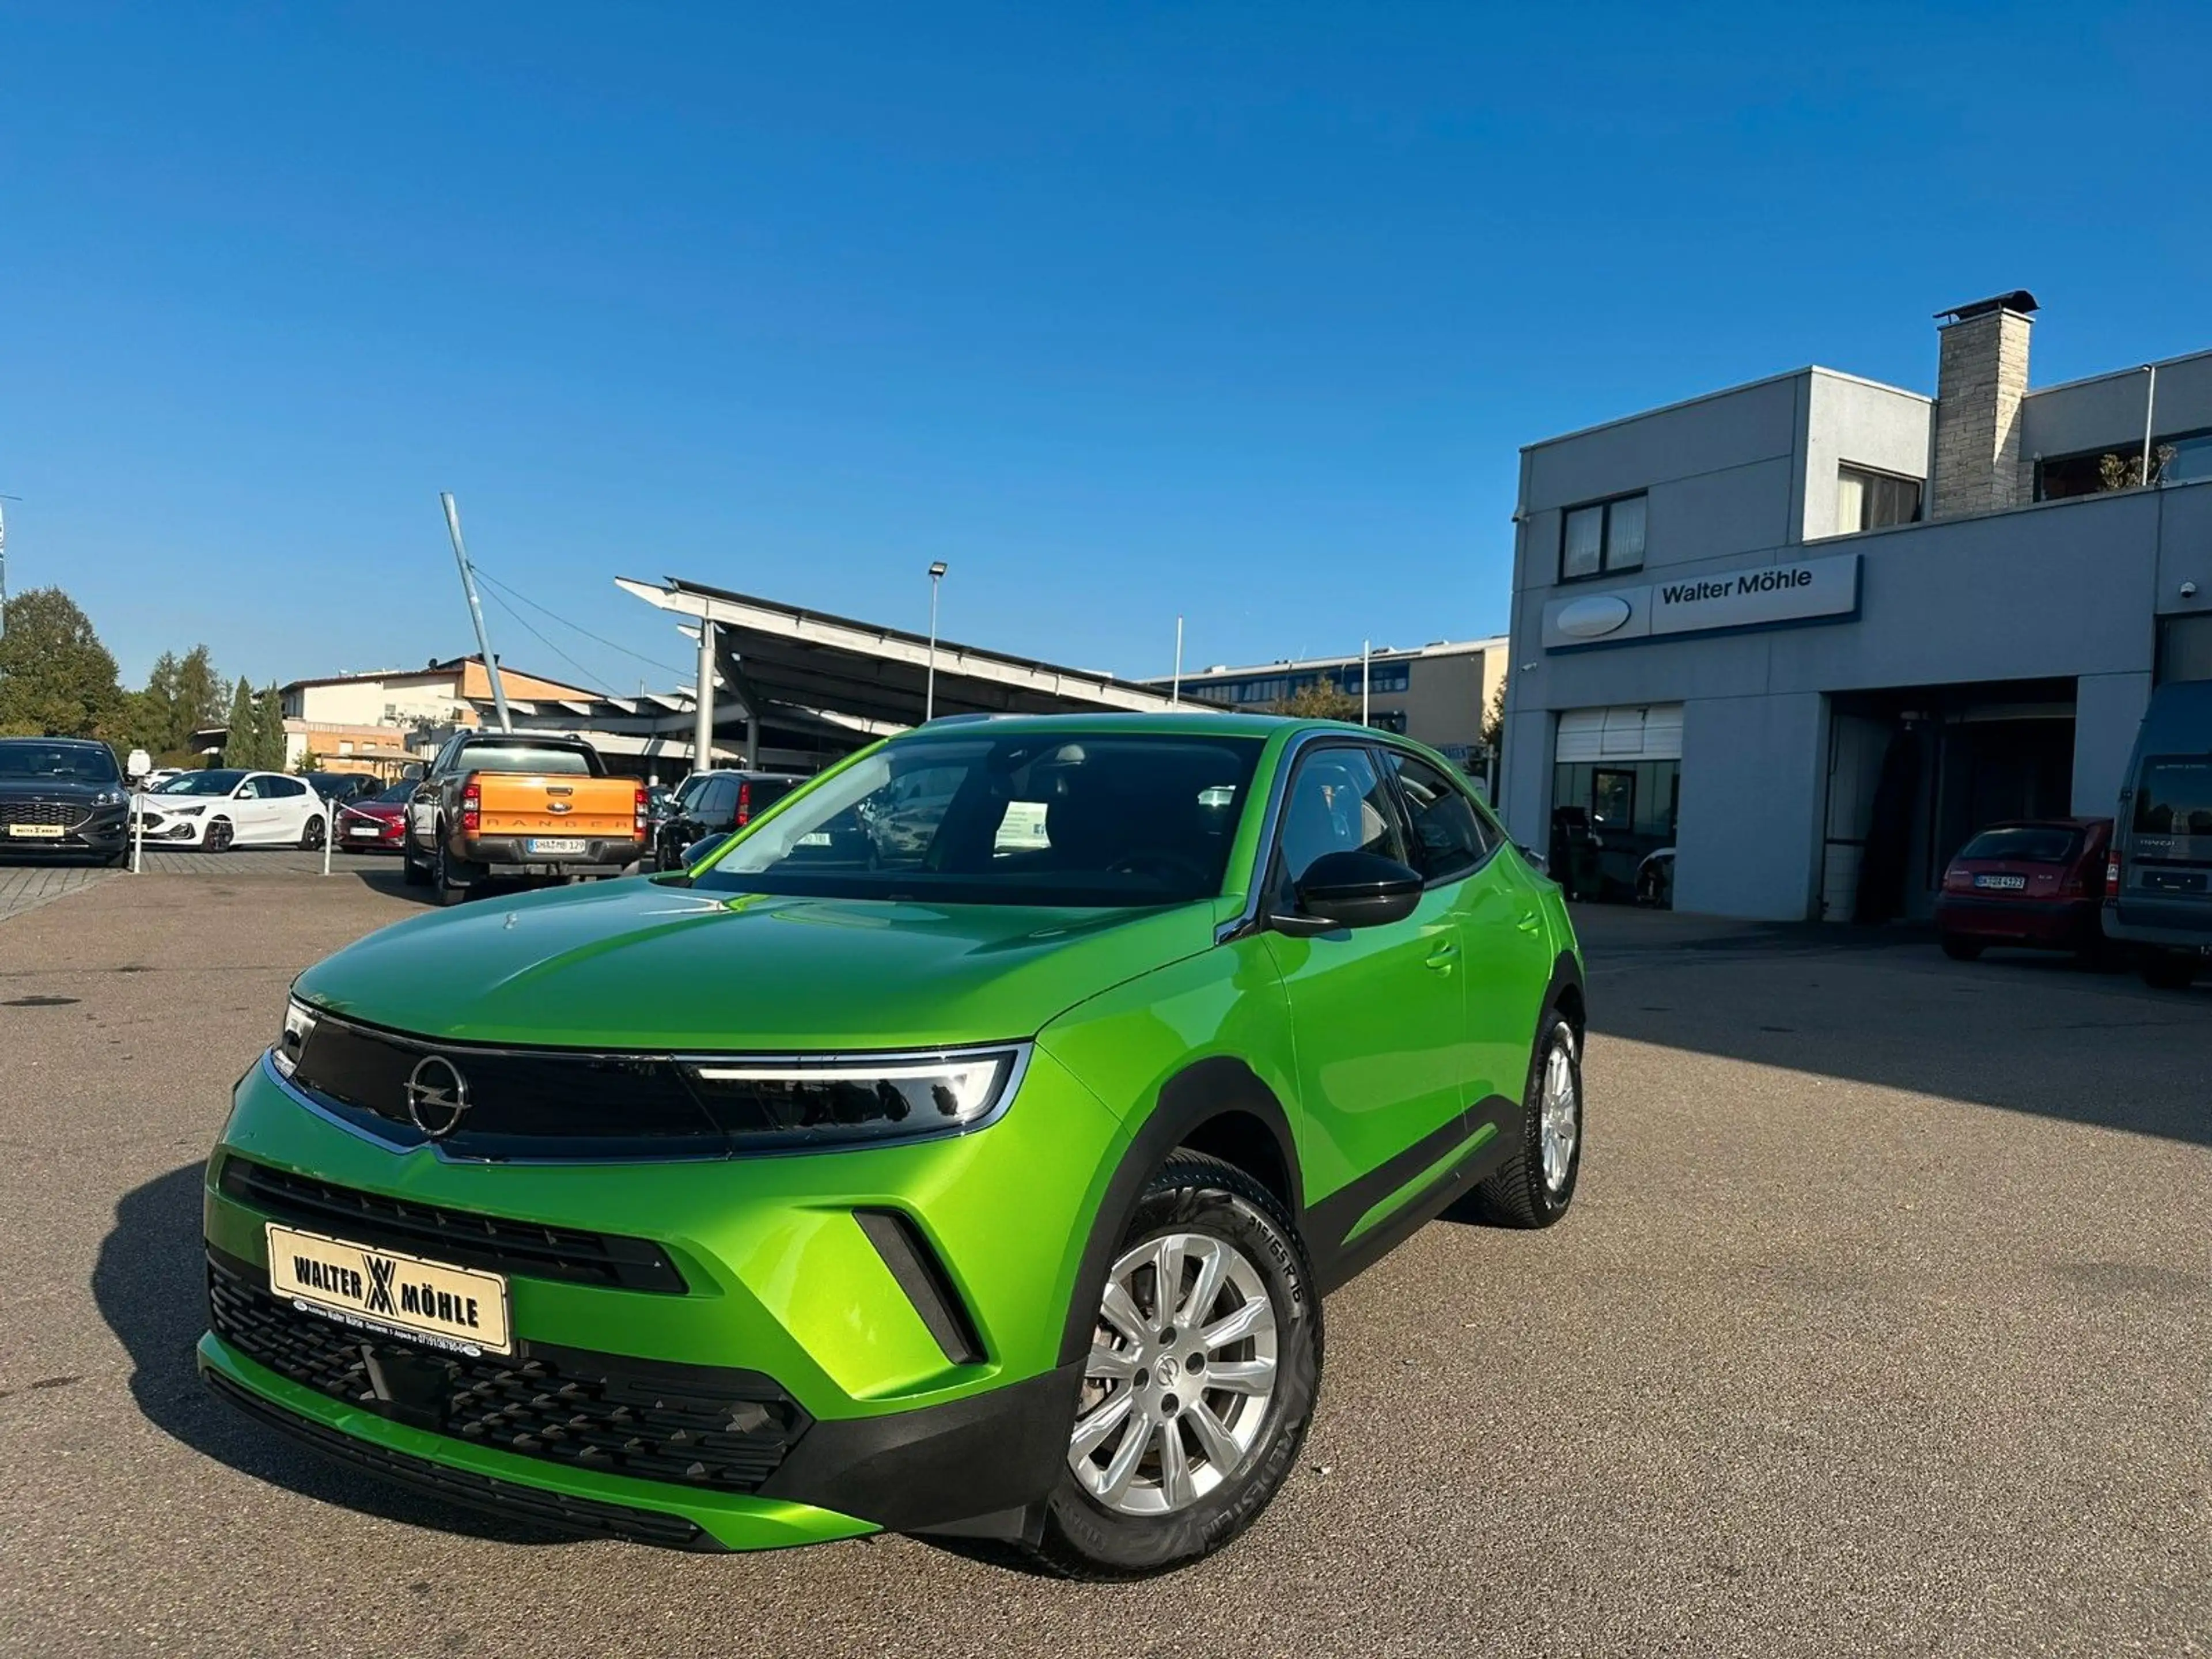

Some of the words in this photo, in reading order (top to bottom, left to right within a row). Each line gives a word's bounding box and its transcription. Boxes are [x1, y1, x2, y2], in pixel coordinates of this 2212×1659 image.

[1662, 582, 1733, 604] Walter
[1737, 569, 1812, 594] Möhle
[293, 1255, 363, 1300] WALTER
[401, 1282, 479, 1328] MÖHLE
[1283, 1261, 1296, 1279] R
[1290, 1278, 1304, 1303] 16
